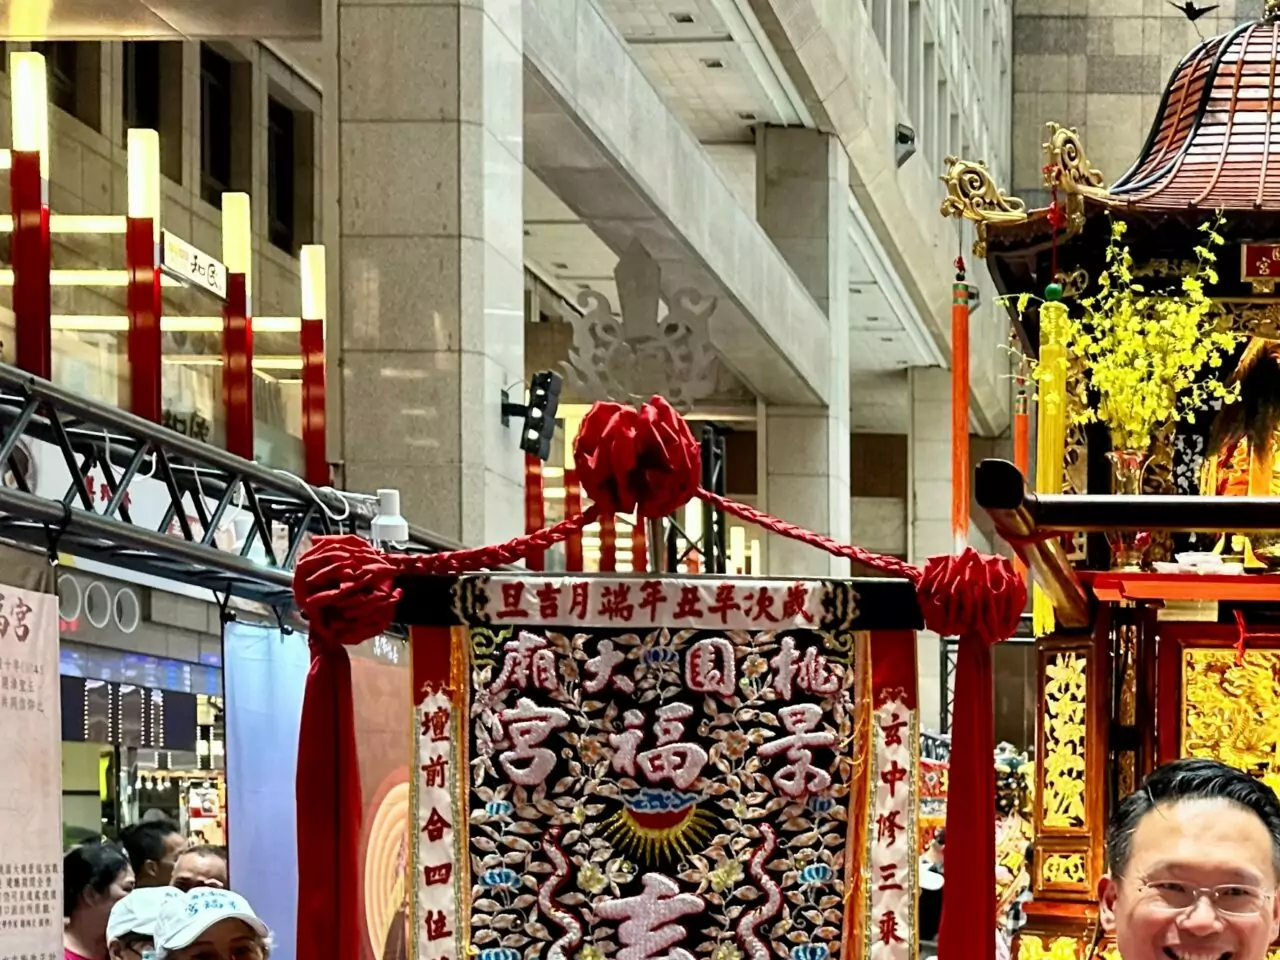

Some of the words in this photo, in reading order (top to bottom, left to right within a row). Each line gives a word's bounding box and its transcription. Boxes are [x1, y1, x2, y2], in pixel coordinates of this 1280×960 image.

[499, 580, 815, 623] 歲次辛丑年端月吉旦
[492, 629, 841, 698] 桃園大廟
[499, 696, 838, 800] 景福宮
